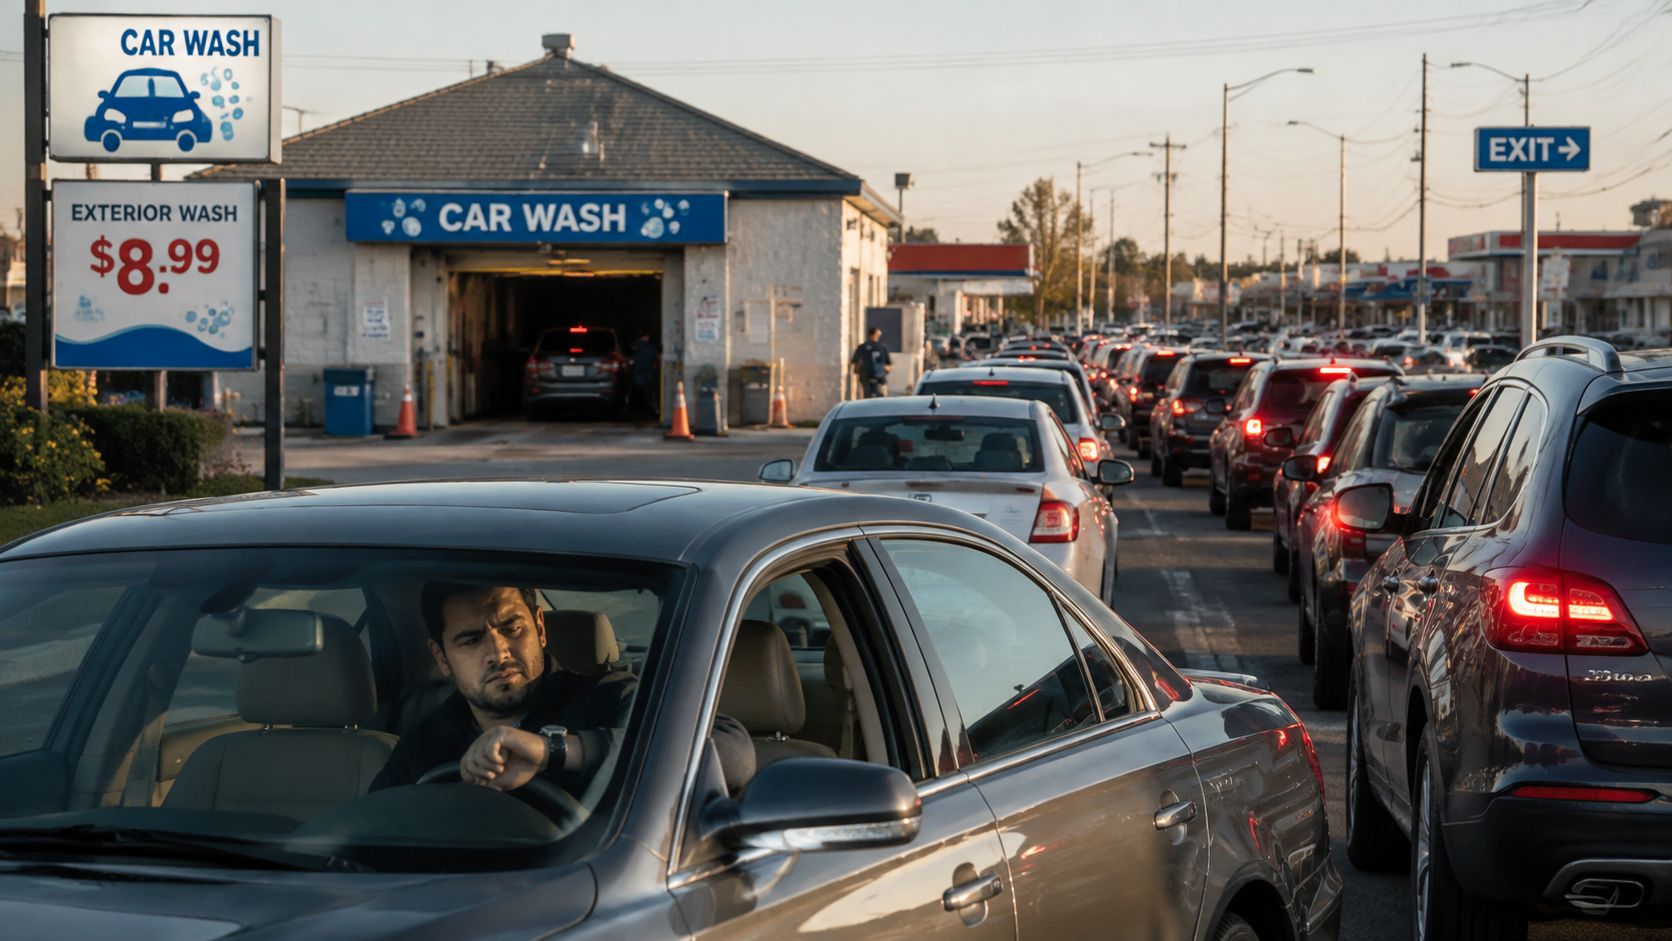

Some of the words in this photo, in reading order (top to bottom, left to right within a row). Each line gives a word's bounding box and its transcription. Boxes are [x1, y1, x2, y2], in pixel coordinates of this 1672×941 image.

[120, 29, 175, 56] CAR
[183, 29, 260, 57] WASH
[1489, 137, 1555, 162] EXIT
[71, 204, 172, 222] EXTERIOR
[179, 204, 238, 222] WASH
[439, 203, 512, 232] CAR
[523, 203, 626, 232] WASH
